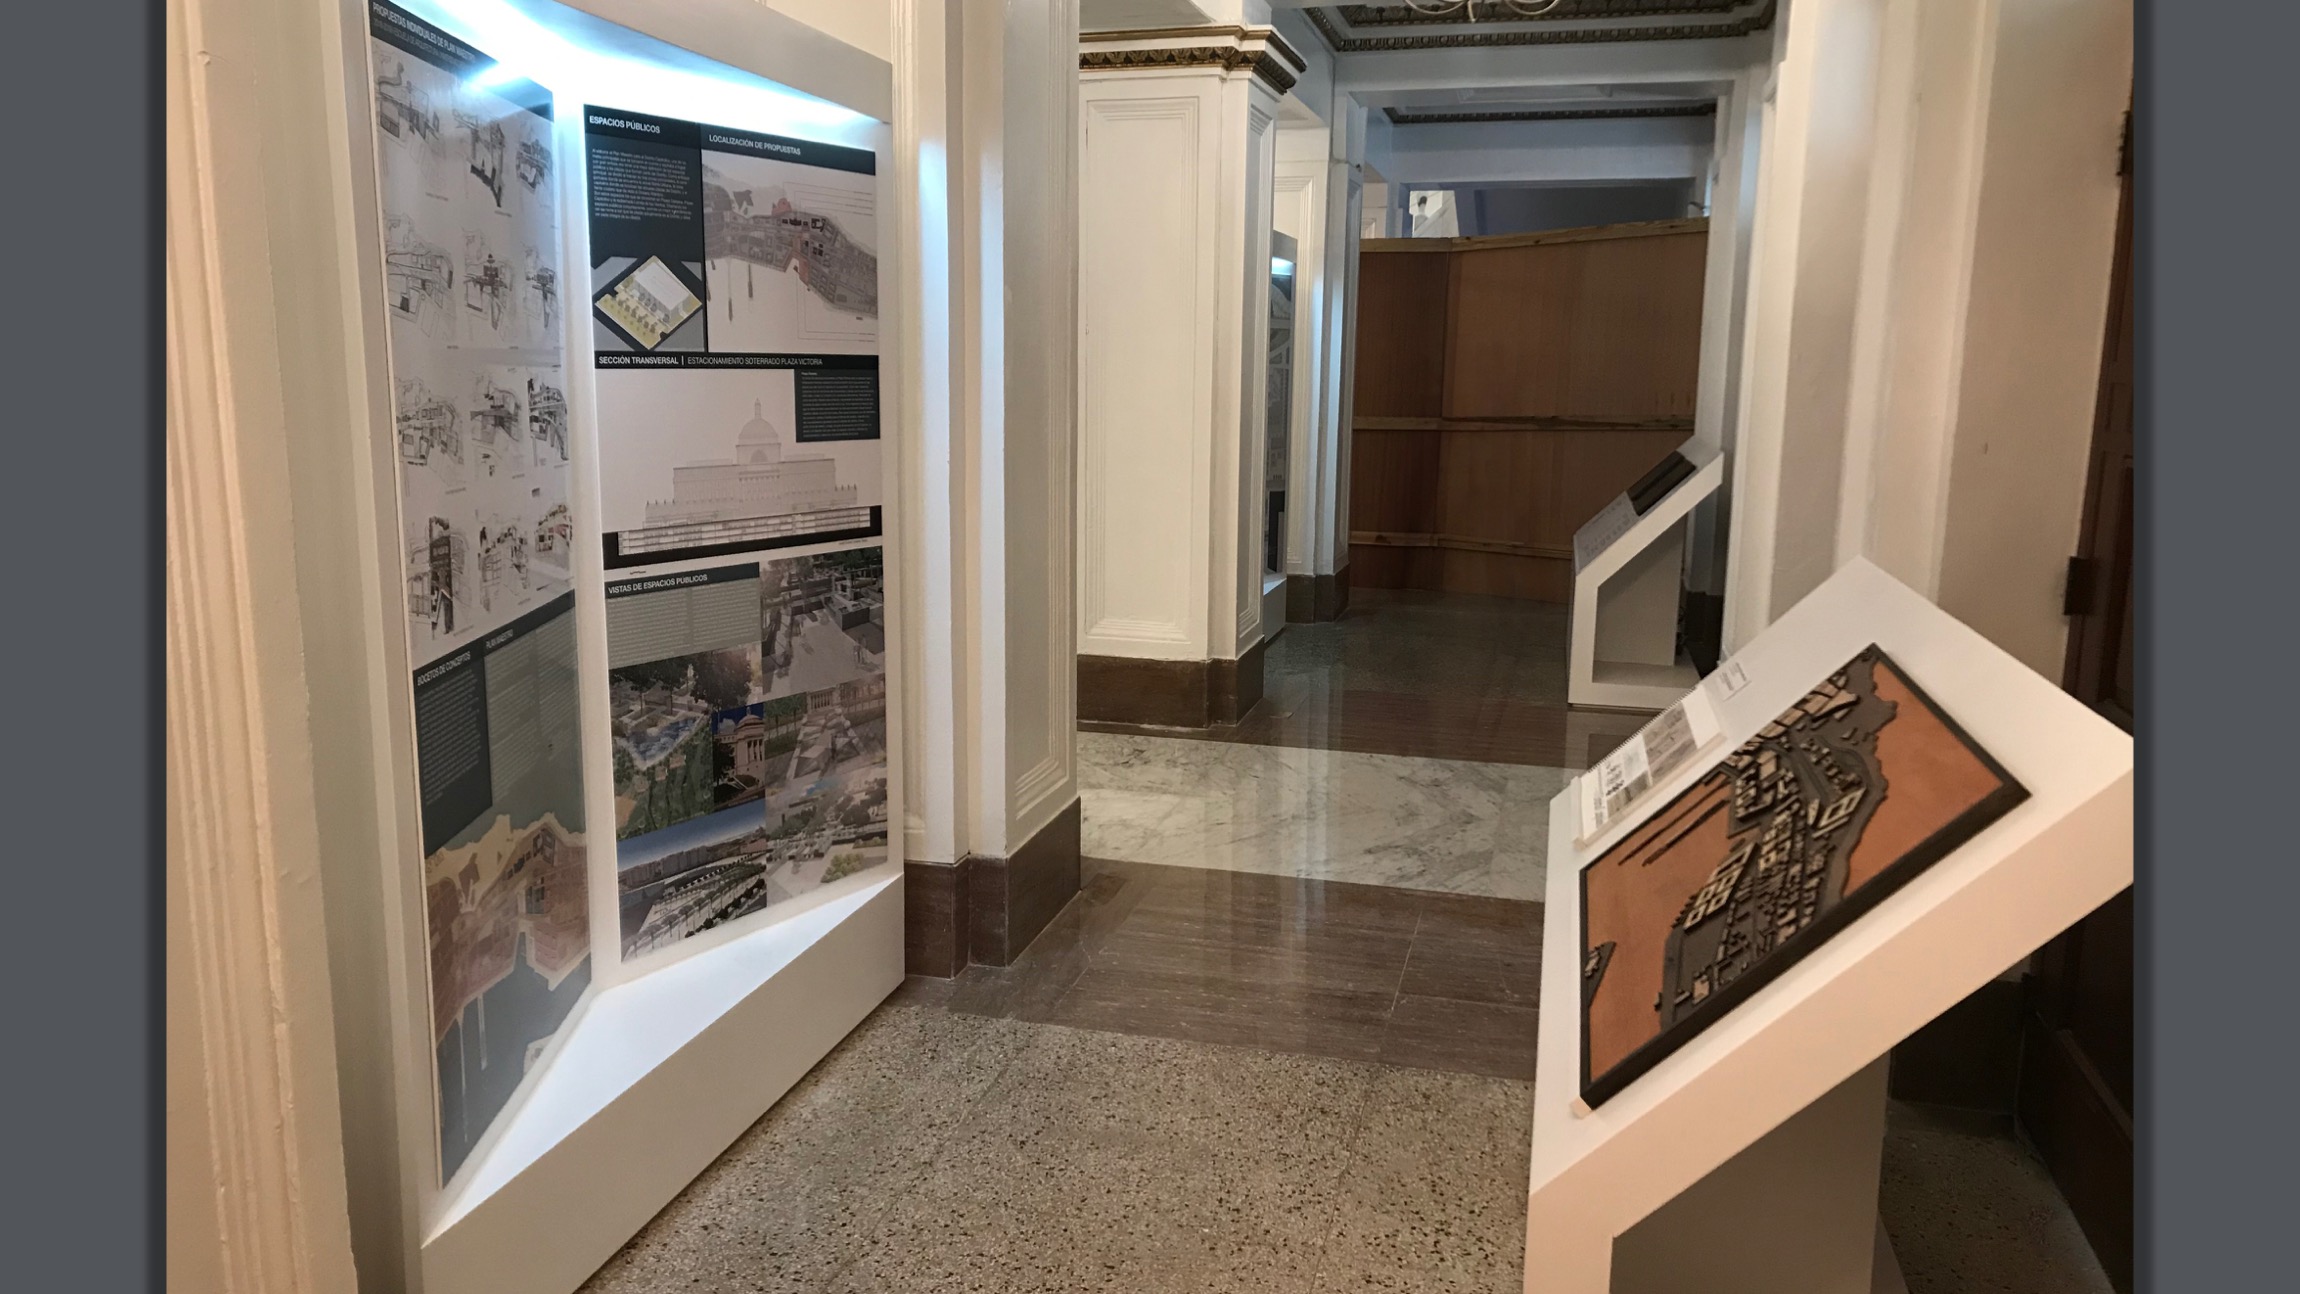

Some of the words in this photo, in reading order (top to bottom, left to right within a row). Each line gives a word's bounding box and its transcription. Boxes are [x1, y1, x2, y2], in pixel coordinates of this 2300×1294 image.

[372, 2, 406, 28] PROPUESTAS
[437, 36, 444, 48] DE
[444, 39, 456, 53] PLAN
[589, 115, 625, 128] ESPACIOS
[625, 120, 661, 134] PÚBLICOS
[708, 134, 754, 148] LOCALIZACIÓN
[754, 141, 763, 149] DE
[763, 142, 801, 156] PROPUESTAS
[598, 355, 630, 365] SECCIÓN
[631, 356, 679, 365] TRANSVERSAL
[687, 356, 744, 365] ESTACIONAMIENTO
[744, 357, 781, 366] SOTERRADO
[781, 357, 798, 366] PLAZA
[799, 358, 823, 366] VICTORIA
[608, 584, 632, 594] VISTAS
[632, 582, 642, 591] DE
[643, 578, 676, 589] ESPACIOS
[417, 667, 439, 686] BOCETOS
[439, 664, 446, 676] DE
[446, 651, 471, 671] CONCEPTOS
